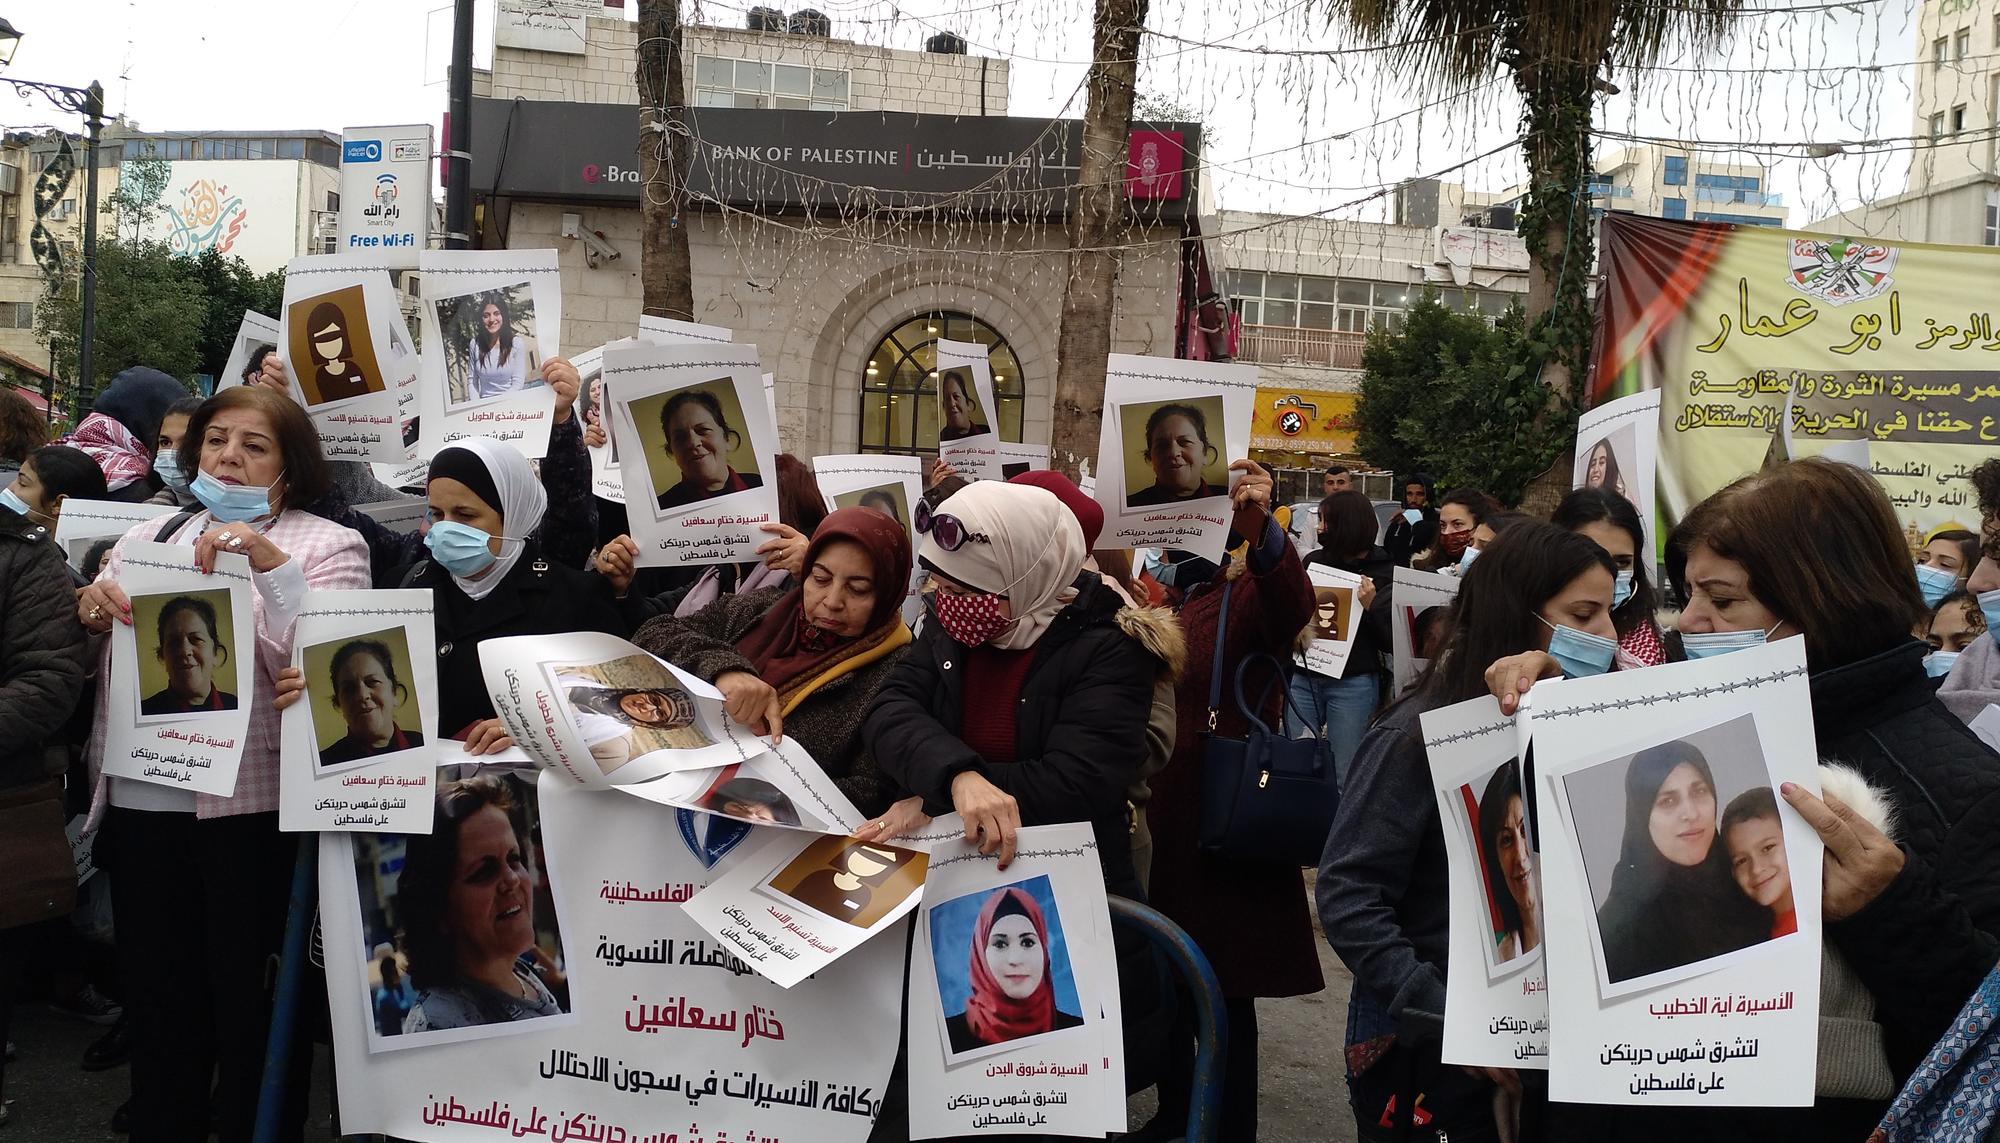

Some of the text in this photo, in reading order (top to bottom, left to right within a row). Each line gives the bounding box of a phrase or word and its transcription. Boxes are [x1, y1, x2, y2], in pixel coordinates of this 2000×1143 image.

[712, 147, 898, 165] BANK OF PALESTINE
[917, 148, 1032, 171] فلسطين
[582, 164, 642, 184] e-Bra
[364, 202, 400, 219] رام الله
[367, 219, 395, 228] Smart City
[350, 233, 414, 247] Free Wi-Fi
[1697, 277, 1819, 353] عمار
[1821, 371, 1884, 399] الثورة
[1890, 375, 1961, 401] مسيرة
[468, 411, 494, 422] الطويل
[1873, 409, 1909, 440] في
[1916, 410, 1973, 433] حقنا
[337, 431, 359, 442] شمس
[360, 432, 381, 444] لتشرق
[499, 430, 524, 442] لتشرق
[327, 446, 370, 457] على فلسطين
[1937, 487, 1967, 506] الله
[681, 516, 715, 528] سعافين
[717, 515, 734, 528] ختام
[1143, 513, 1176, 522] سعافين
[1176, 512, 1193, 522] ختام
[659, 533, 750, 549] لتشرق شمس حريتكن
[1116, 526, 1203, 538] لتشرق شمس حريتكن
[1131, 537, 1183, 547] على فلسطين
[679, 548, 736, 562] على فلسطين
[157, 727, 188, 740] سعافين
[187, 732, 205, 745] ختام
[130, 746, 212, 769] لتشرق شمس حريتكن
[143, 764, 192, 782] على فلسطين
[342, 775, 377, 787] سعافين
[377, 775, 395, 789] ختام
[314, 797, 406, 811] لتشرق شمس حريتكن
[334, 814, 389, 826] على فلسطين
[599, 880, 694, 905] الفلسطينية
[766, 905, 793, 924] الأسد
[722, 904, 801, 961] لتشرق شمس حريتكن
[782, 921, 811, 941] تسنيم
[596, 935, 674, 967] النسوية
[720, 926, 768, 962] على فلسطين
[1649, 996, 1708, 1020] الخطيب
[1711, 992, 1733, 1018] آية
[625, 995, 785, 1048] ختام سعافين
[1489, 1016, 1528, 1034] حريتكن
[1600, 1036, 1759, 1066] لتشرق شمس حريتكن
[539, 1049, 609, 1083] الاحتلال
[986, 1061, 1014, 1077] البدن
[1015, 1060, 1048, 1077] شروق
[613, 1060, 681, 1095] سجون
[1629, 1071, 1725, 1096] على فلسطين
[685, 1070, 718, 1107] في
[723, 1072, 819, 1109] الأسيرات
[947, 1089, 1068, 1110] لتشرق شمس حريتكن
[423, 1094, 511, 1127] فلسطين
[511, 1106, 548, 1138] على
[972, 1112, 1048, 1128] على فلسطين
